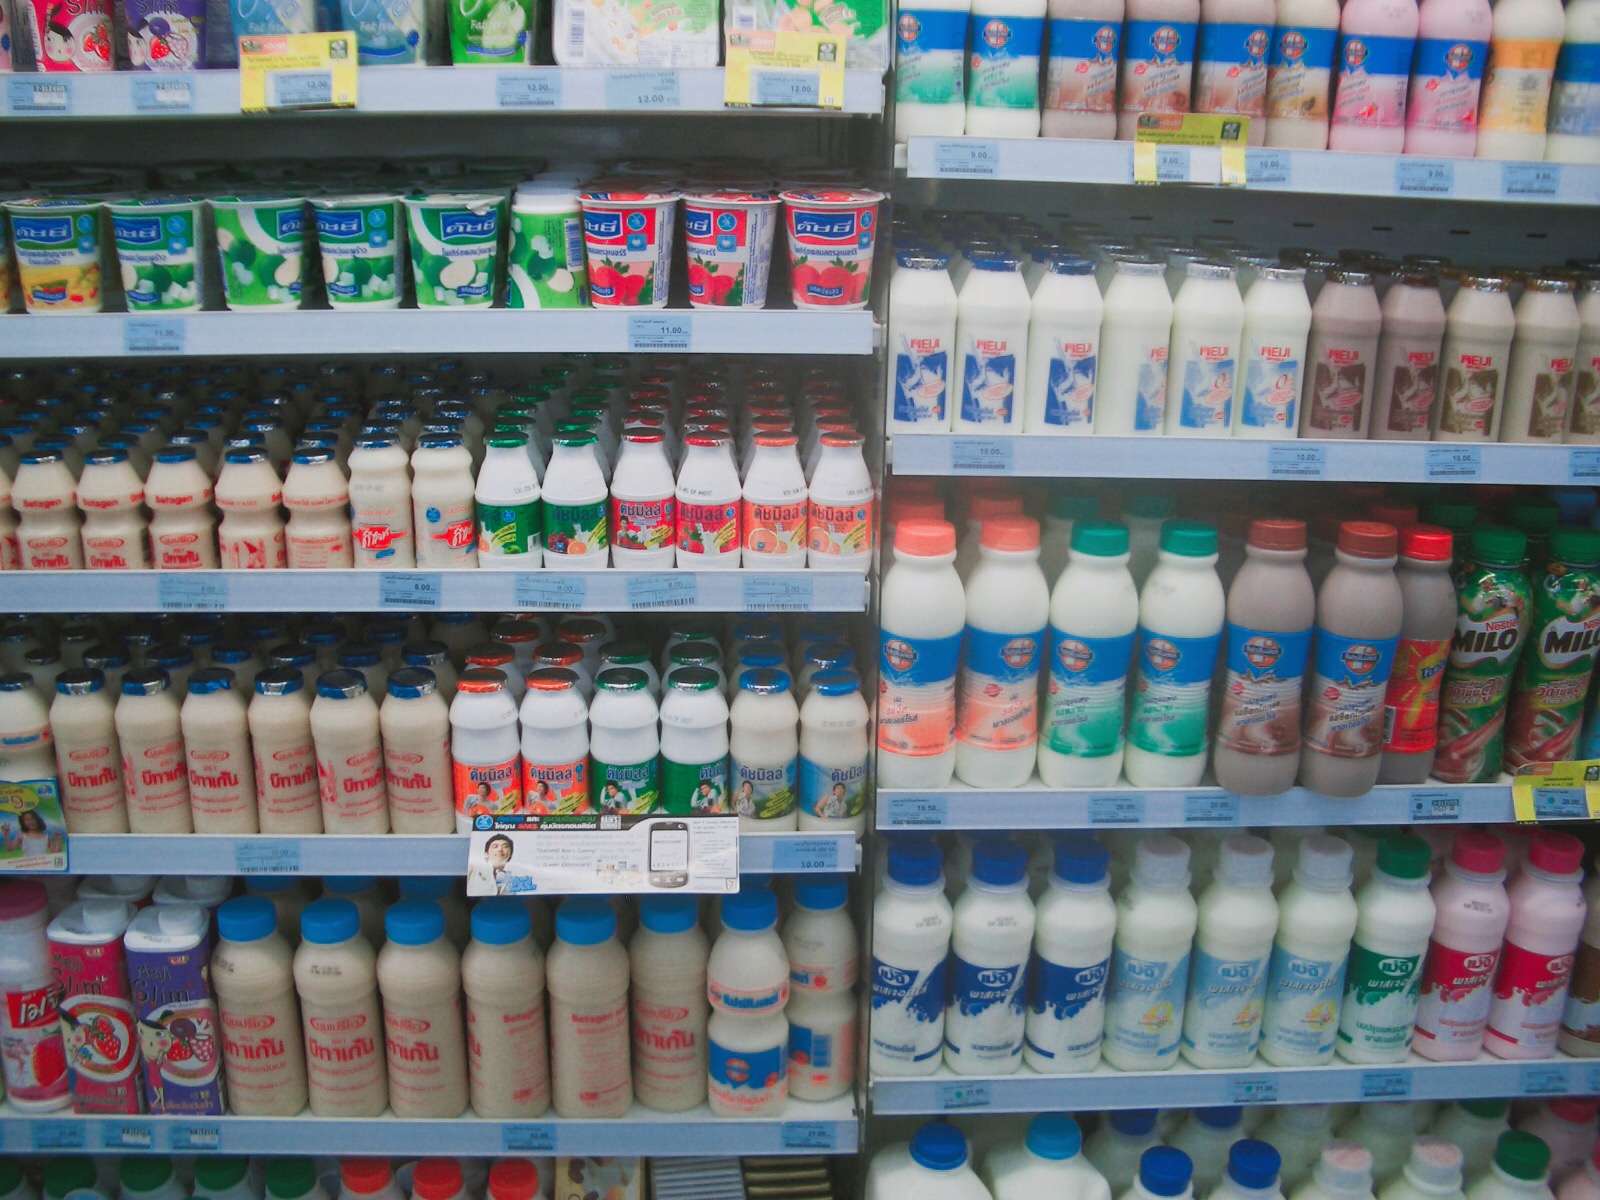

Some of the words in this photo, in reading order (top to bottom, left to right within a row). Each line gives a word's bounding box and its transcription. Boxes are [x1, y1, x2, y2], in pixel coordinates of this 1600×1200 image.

[637, 94, 664, 103] 12.00
[910, 338, 940, 349] MEIJI
[976, 339, 1007, 351] MEIJI
[1064, 342, 1092, 353] MEIJI
[1199, 346, 1229, 357] MEIJI
[1261, 346, 1291, 358] MEIJI
[1328, 349, 1359, 361] MEIJI
[1460, 354, 1492, 367] MEIJI
[980, 448, 1000, 456] 10.00
[1454, 628, 1519, 654] MILO
[470, 764, 513, 781] ดัชมิลล์
[530, 765, 573, 781] ดัชมิลล์
[740, 765, 784, 781] ดัชมิลล์
[51, 967, 102, 996] Slim
[133, 979, 190, 1003] Slim
